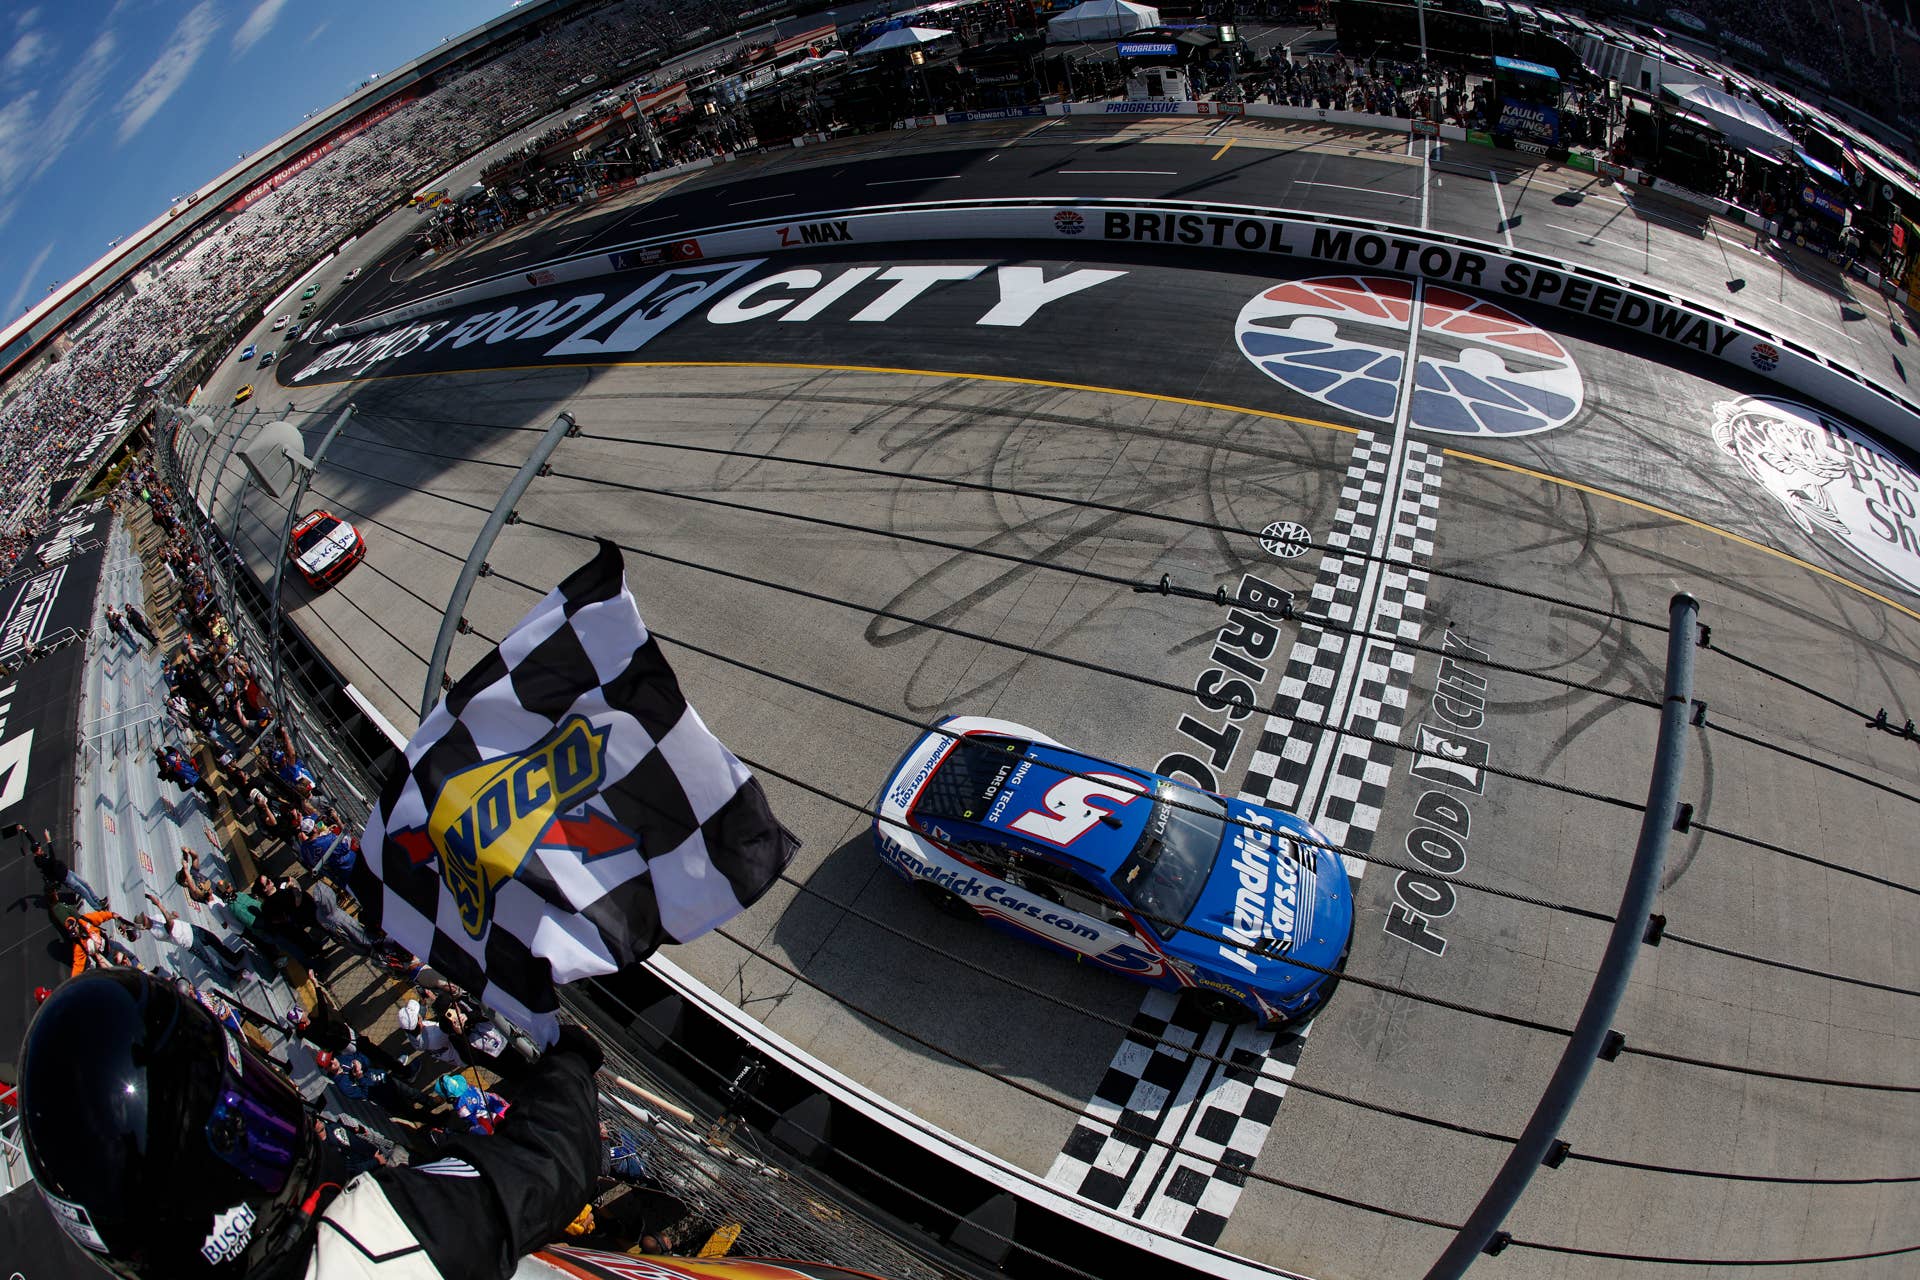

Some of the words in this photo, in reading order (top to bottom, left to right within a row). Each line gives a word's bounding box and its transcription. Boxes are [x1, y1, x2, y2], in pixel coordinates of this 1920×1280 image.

[975, 76, 1004, 84] Delaware
[1006, 73, 1018, 81] Life
[1120, 44, 1173, 53] PROGRESSIVE
[966, 109, 1005, 121] Delaware
[1006, 108, 1023, 117] Life
[1105, 102, 1181, 113] PROGRESSIVE
[1502, 104, 1545, 122] KAULIG
[244, 179, 273, 202] GREAT
[274, 151, 318, 184] MOMENTS
[425, 293, 606, 352] FOOD
[706, 265, 1131, 328] CITY
[1103, 211, 1295, 254] BRISTOL
[1310, 227, 1488, 287] MOTOR
[1499, 263, 1743, 357] SPEEDWAY
[1818, 415, 1919, 493] Bass
[1847, 459, 1917, 519] Pro
[320, 532, 354, 559] Kroger
[1866, 497, 1920, 557] Sh
[1152, 573, 1295, 796] BRISTO
[897, 734, 954, 809] HendrickCars.com
[1011, 752, 1039, 786] HRING
[1383, 790, 1470, 957] FOOD
[1431, 628, 1490, 730] CITY
[988, 790, 1014, 824] TECHS
[1007, 771, 1150, 847] 5
[882, 835, 1101, 942] HendrickCars.com
[1219, 808, 1273, 974] Hendrick
[1199, 978, 1247, 1000] GOODYEAR
[204, 1205, 256, 1265] BUSCH
[225, 1230, 252, 1262] LIGHT
